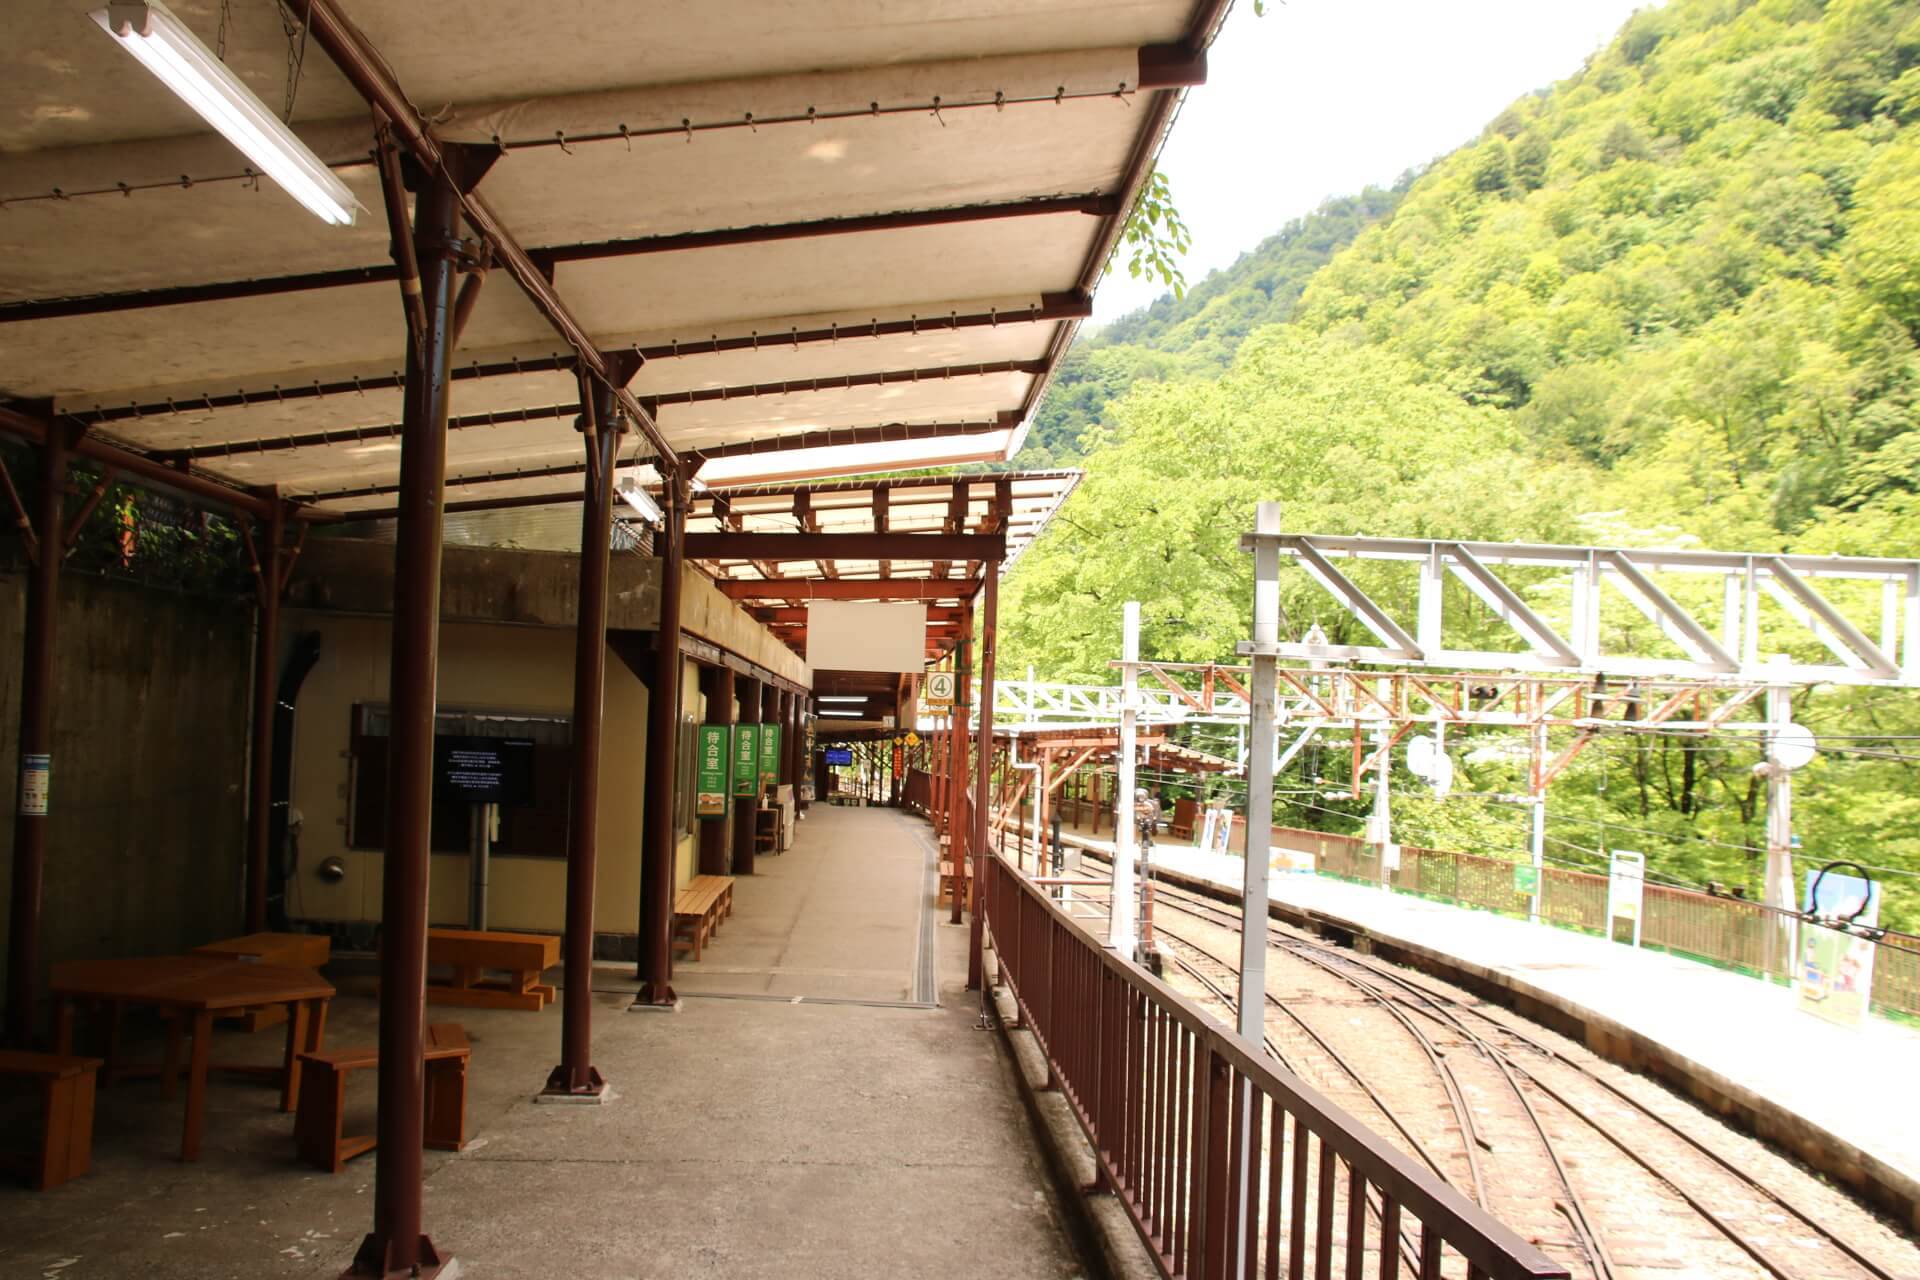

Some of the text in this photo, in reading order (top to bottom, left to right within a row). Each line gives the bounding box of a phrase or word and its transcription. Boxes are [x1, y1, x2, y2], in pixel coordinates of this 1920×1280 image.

[934, 677, 946, 695] 4
[706, 731, 720, 770] 待合室
[741, 730, 752, 761] 待合室
